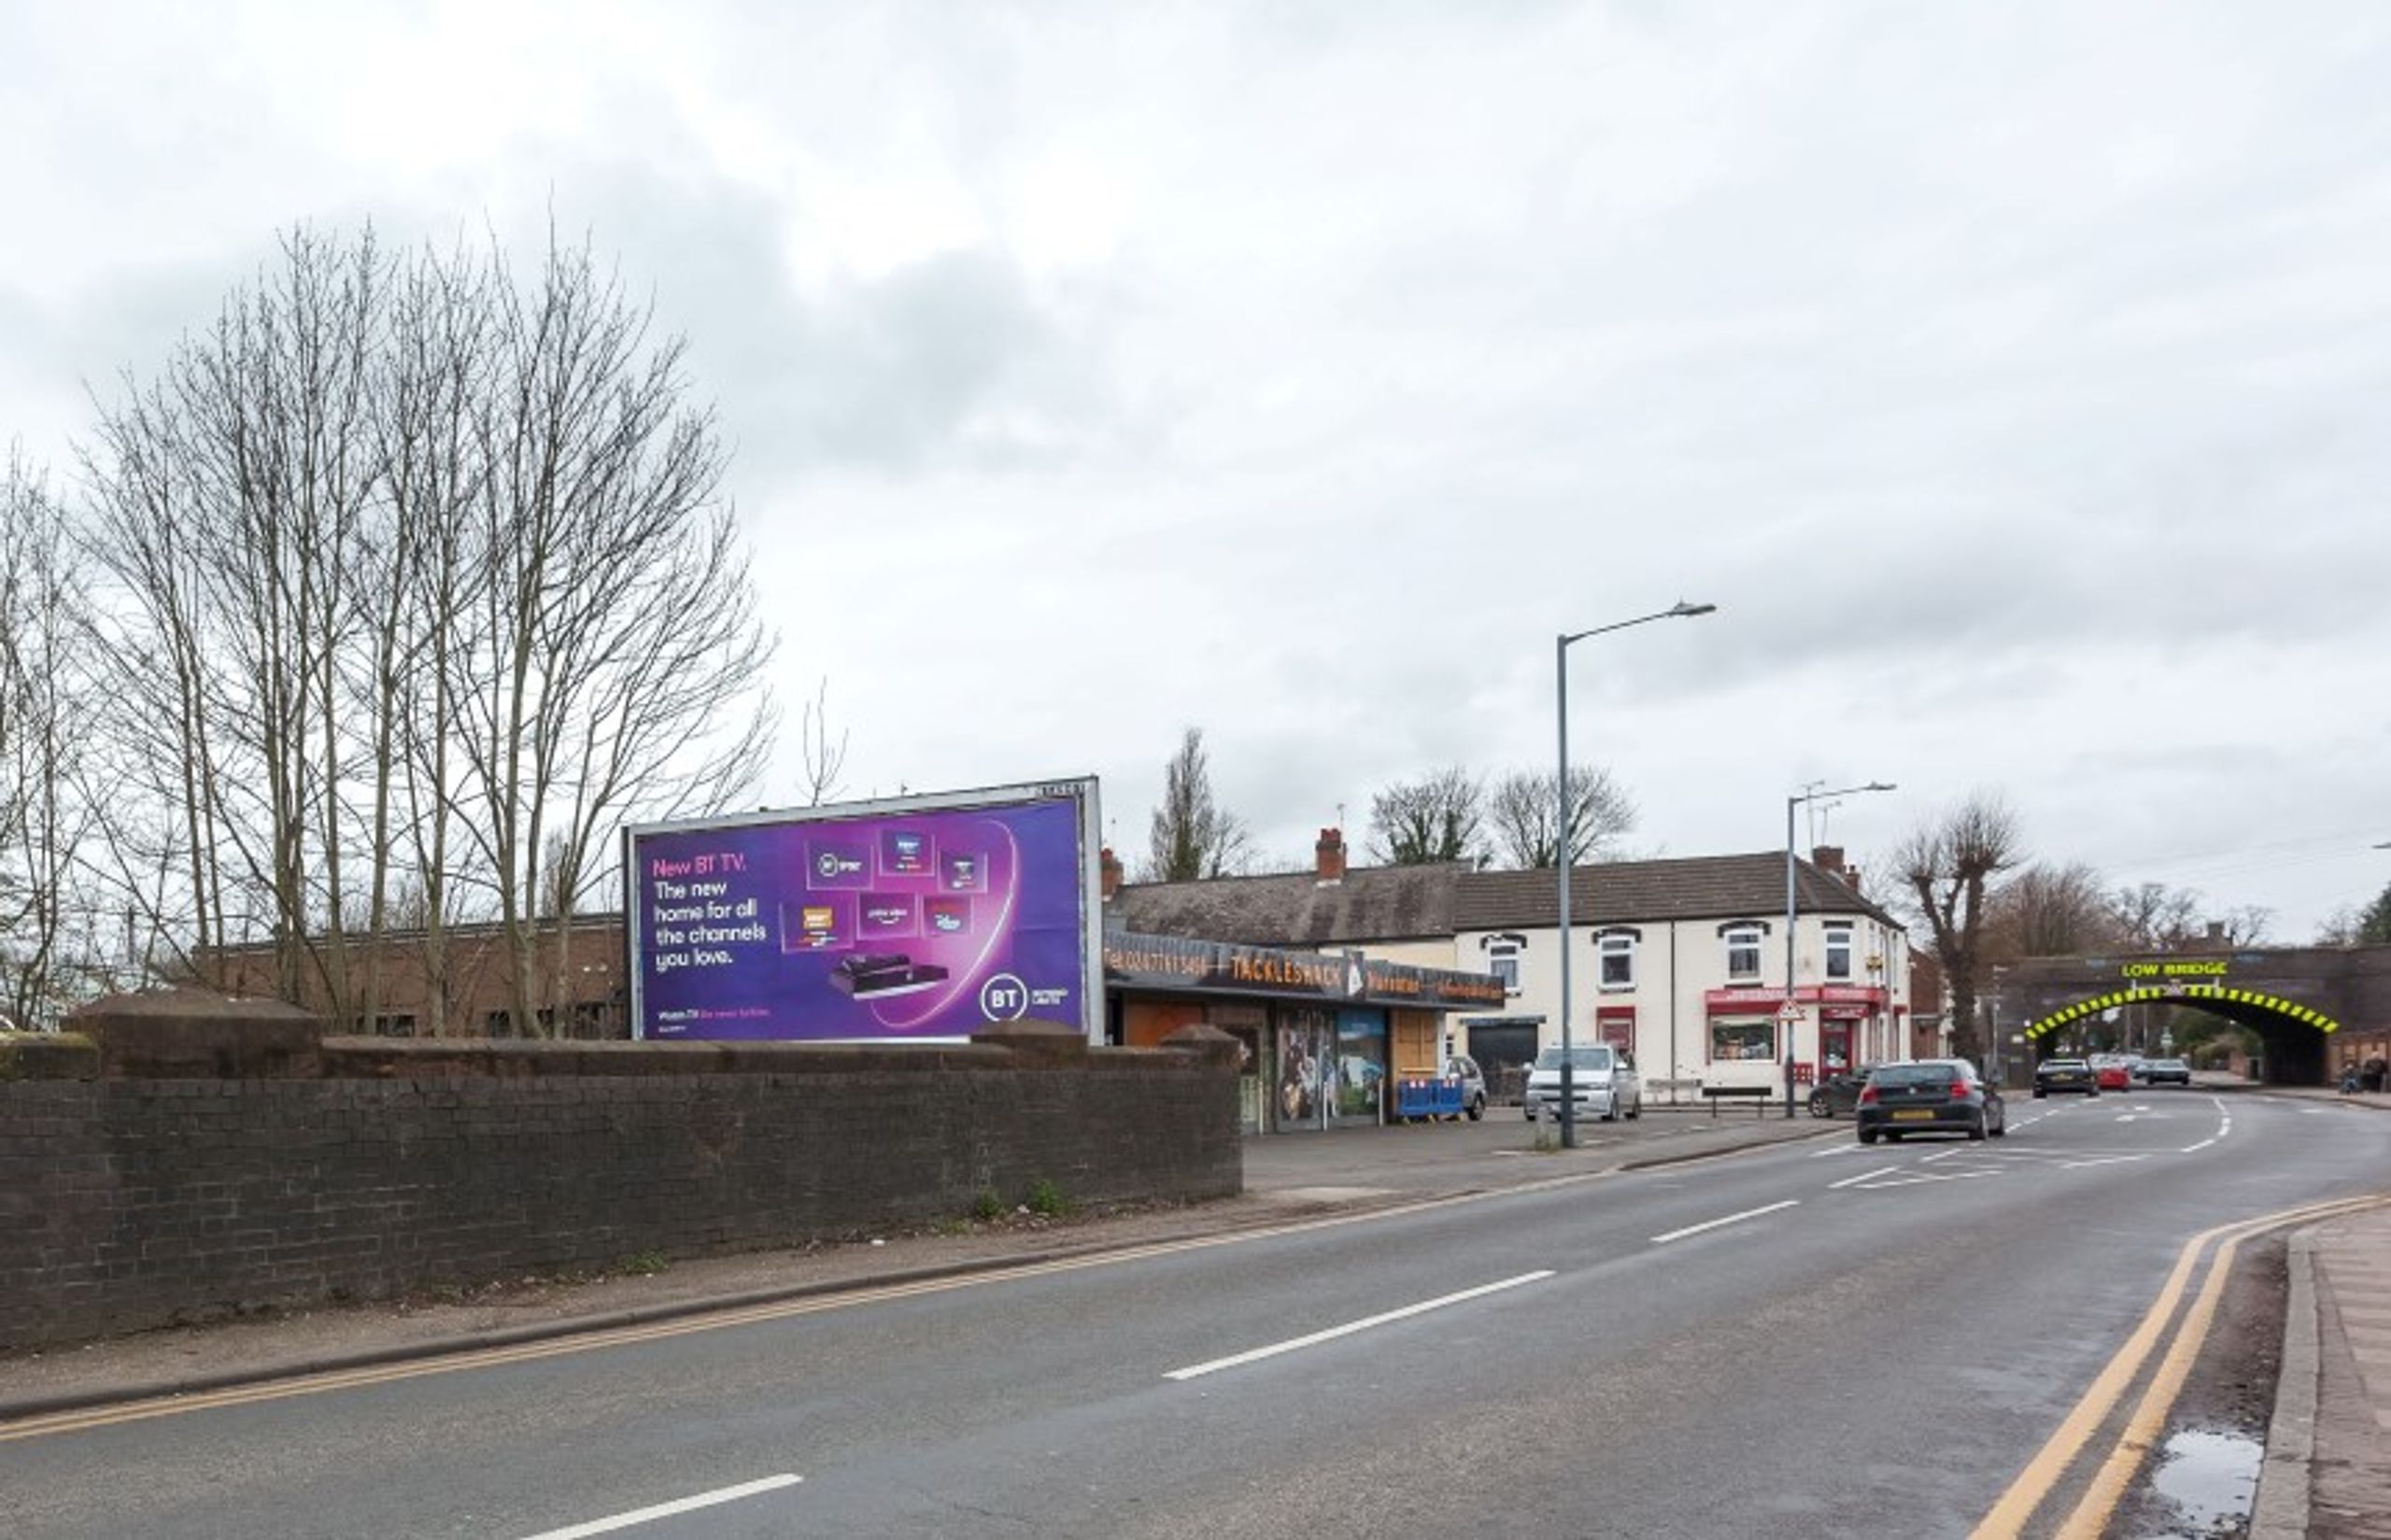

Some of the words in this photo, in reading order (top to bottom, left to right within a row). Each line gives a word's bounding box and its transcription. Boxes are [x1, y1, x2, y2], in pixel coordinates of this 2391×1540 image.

[653, 858, 691, 877] New
[695, 855, 717, 874] BT
[720, 853, 746, 871] TV.
[654, 881, 687, 899] The
[691, 883, 727, 897] new
[654, 905, 704, 922] home
[707, 900, 732, 919] for
[735, 897, 757, 918] all
[656, 926, 685, 946] the
[689, 922, 766, 944] channels
[656, 953, 689, 973] you
[693, 948, 733, 966] love.
[2121, 964, 2159, 977] LOW
[2163, 962, 2228, 976] BRIDGE
[992, 989, 1018, 1008] BT
